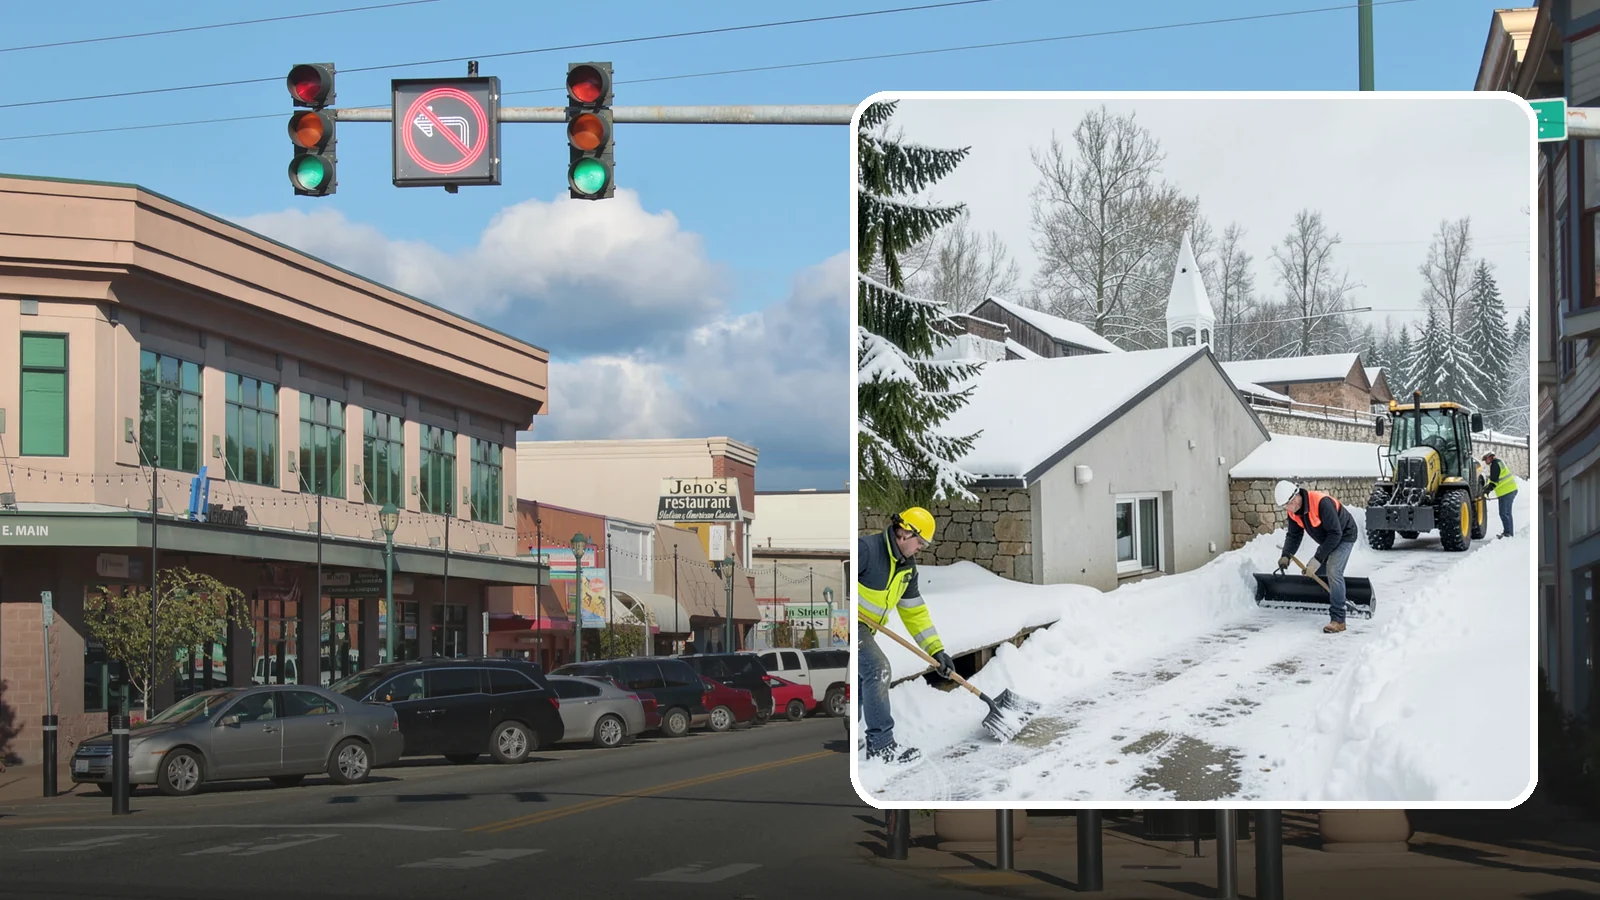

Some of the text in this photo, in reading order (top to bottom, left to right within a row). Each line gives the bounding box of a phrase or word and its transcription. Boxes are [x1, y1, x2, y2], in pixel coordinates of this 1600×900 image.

[669, 480, 727, 494] Jeno's
[665, 496, 730, 509] restaurant
[658, 510, 681, 519] Italian
[686, 510, 714, 519] American
[715, 510, 737, 519] Cuisine
[2, 525, 49, 536] E. MAIN
[797, 608, 828, 616] Street
